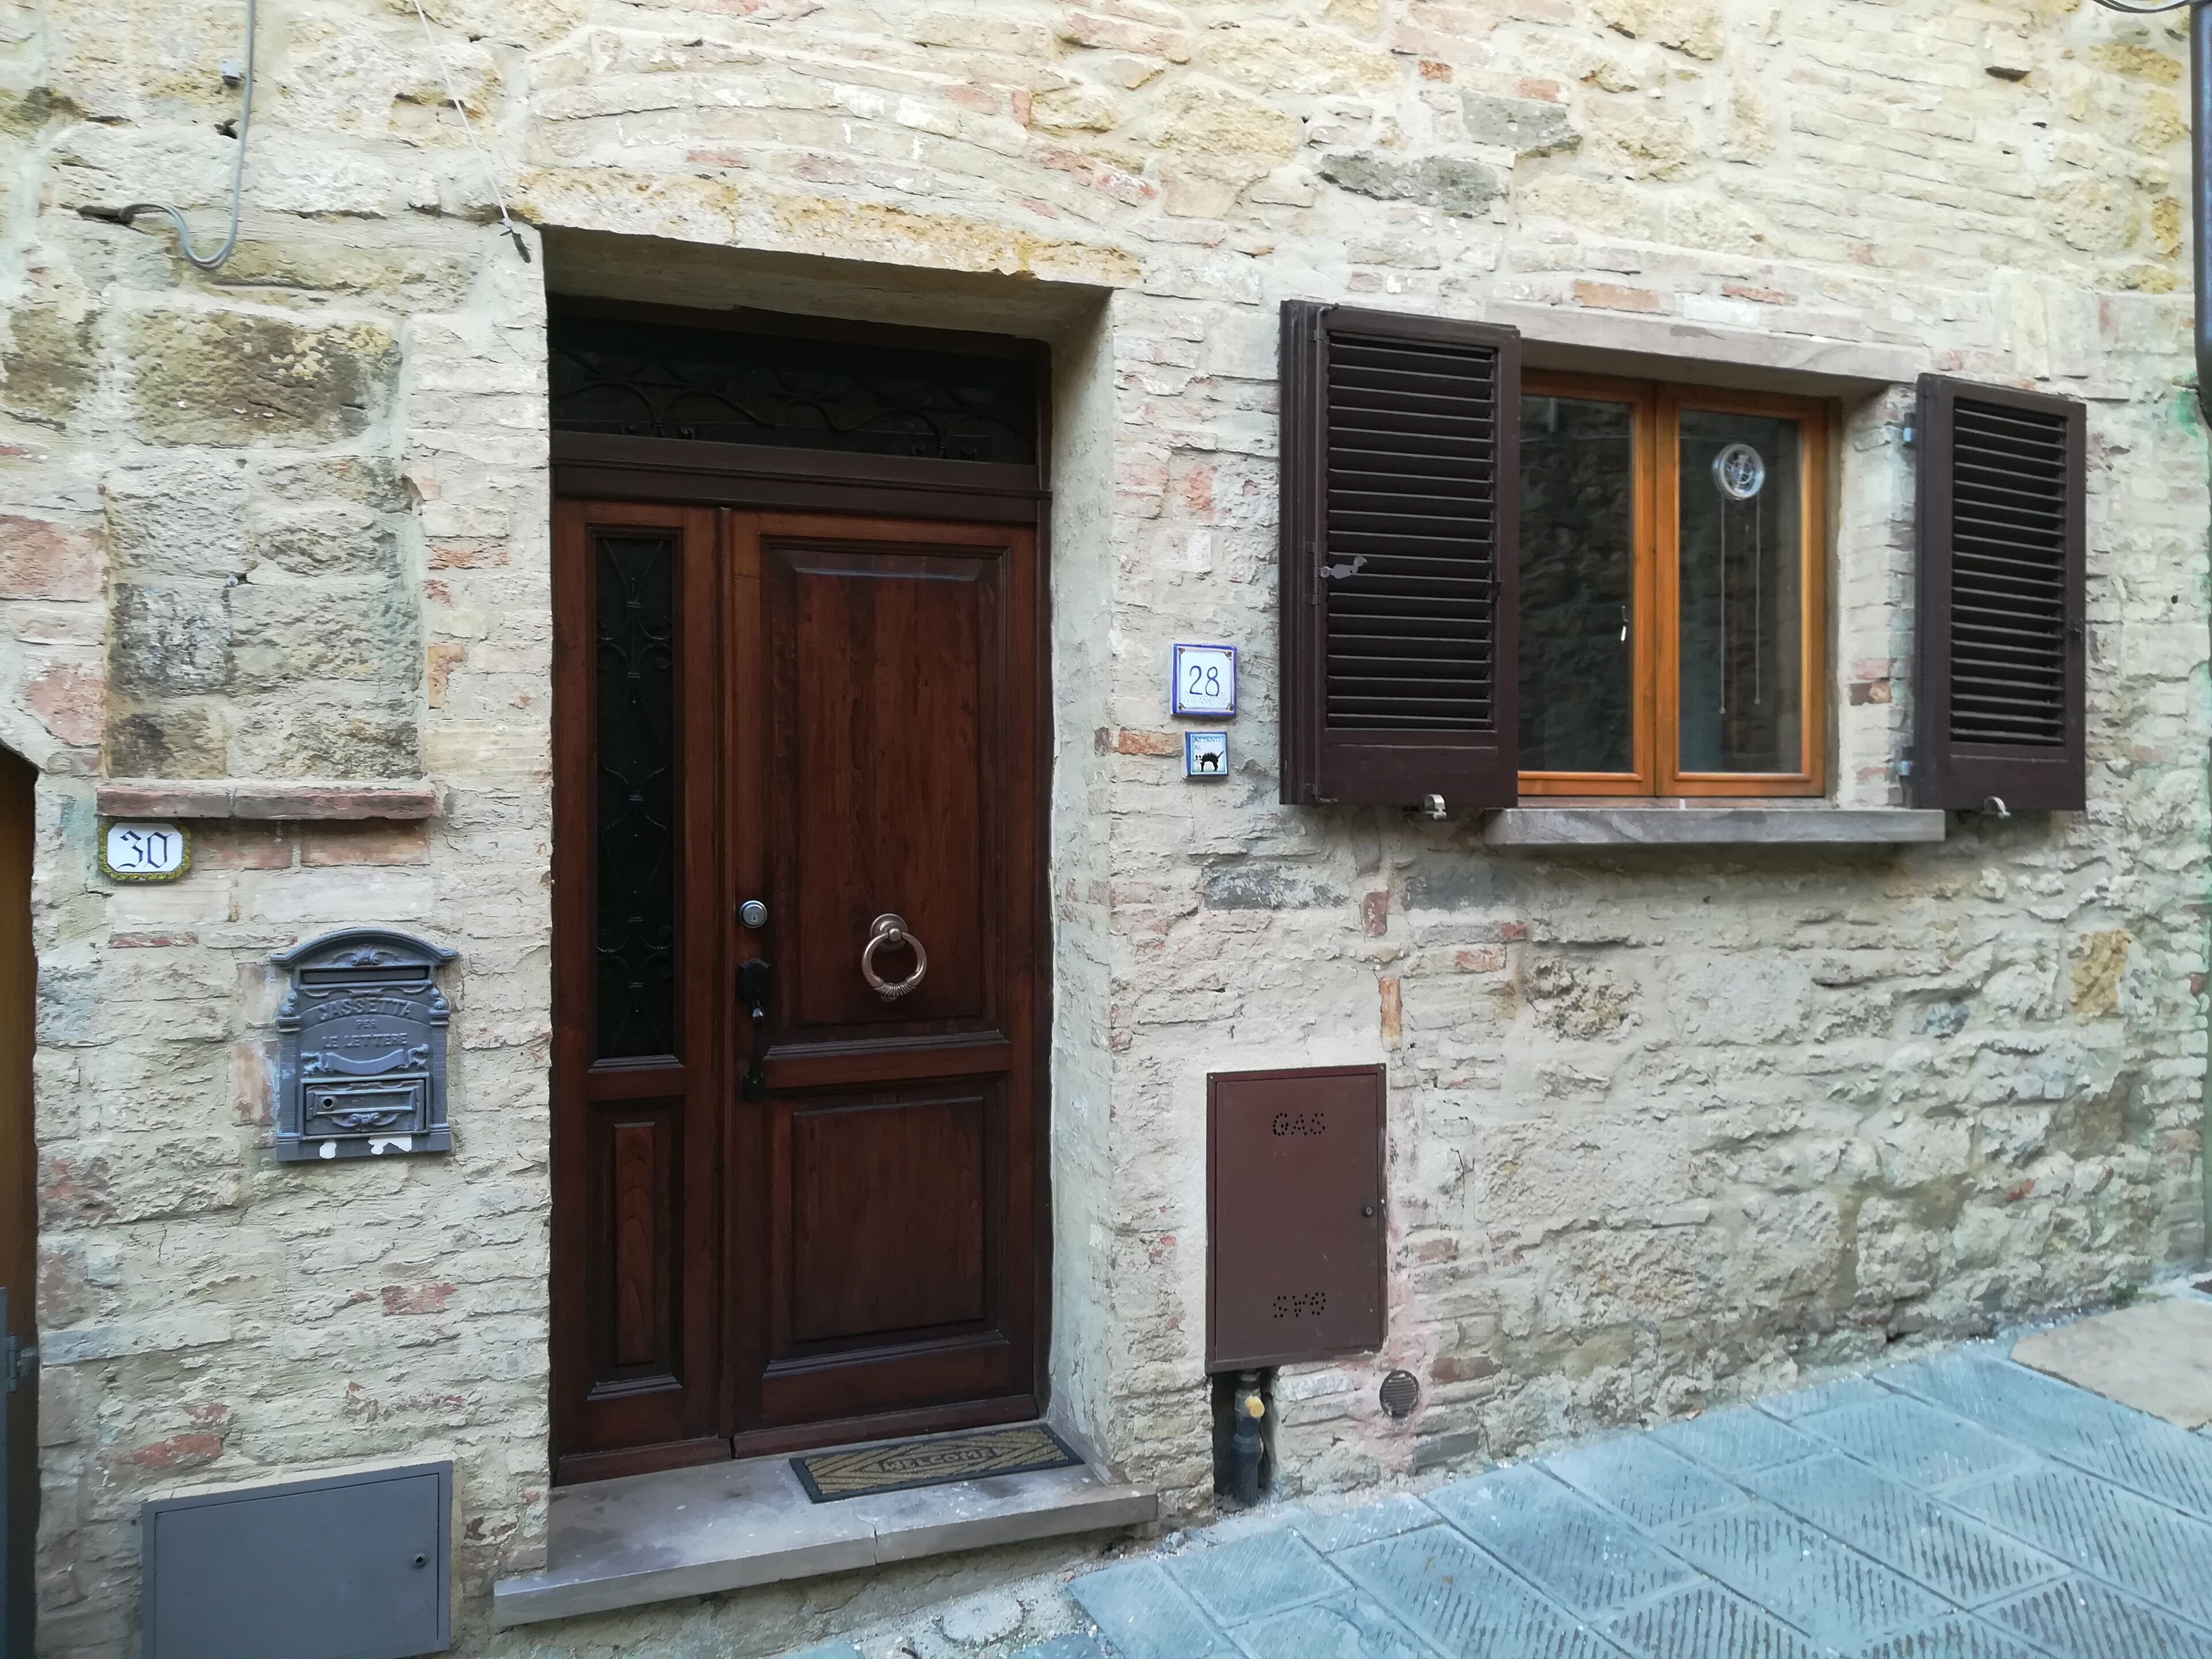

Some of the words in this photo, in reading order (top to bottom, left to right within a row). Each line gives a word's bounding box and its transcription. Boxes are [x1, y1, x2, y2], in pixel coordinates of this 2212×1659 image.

[1189, 665, 1220, 696] 28
[116, 830, 172, 869] 30
[318, 997, 411, 1021] CASSETTA
[355, 1018, 377, 1029] PER
[321, 1035, 339, 1049] LE
[343, 1032, 408, 1049] LETTERE
[1272, 1112, 1326, 1137] GAS
[881, 1448, 993, 1472] WELCOME
